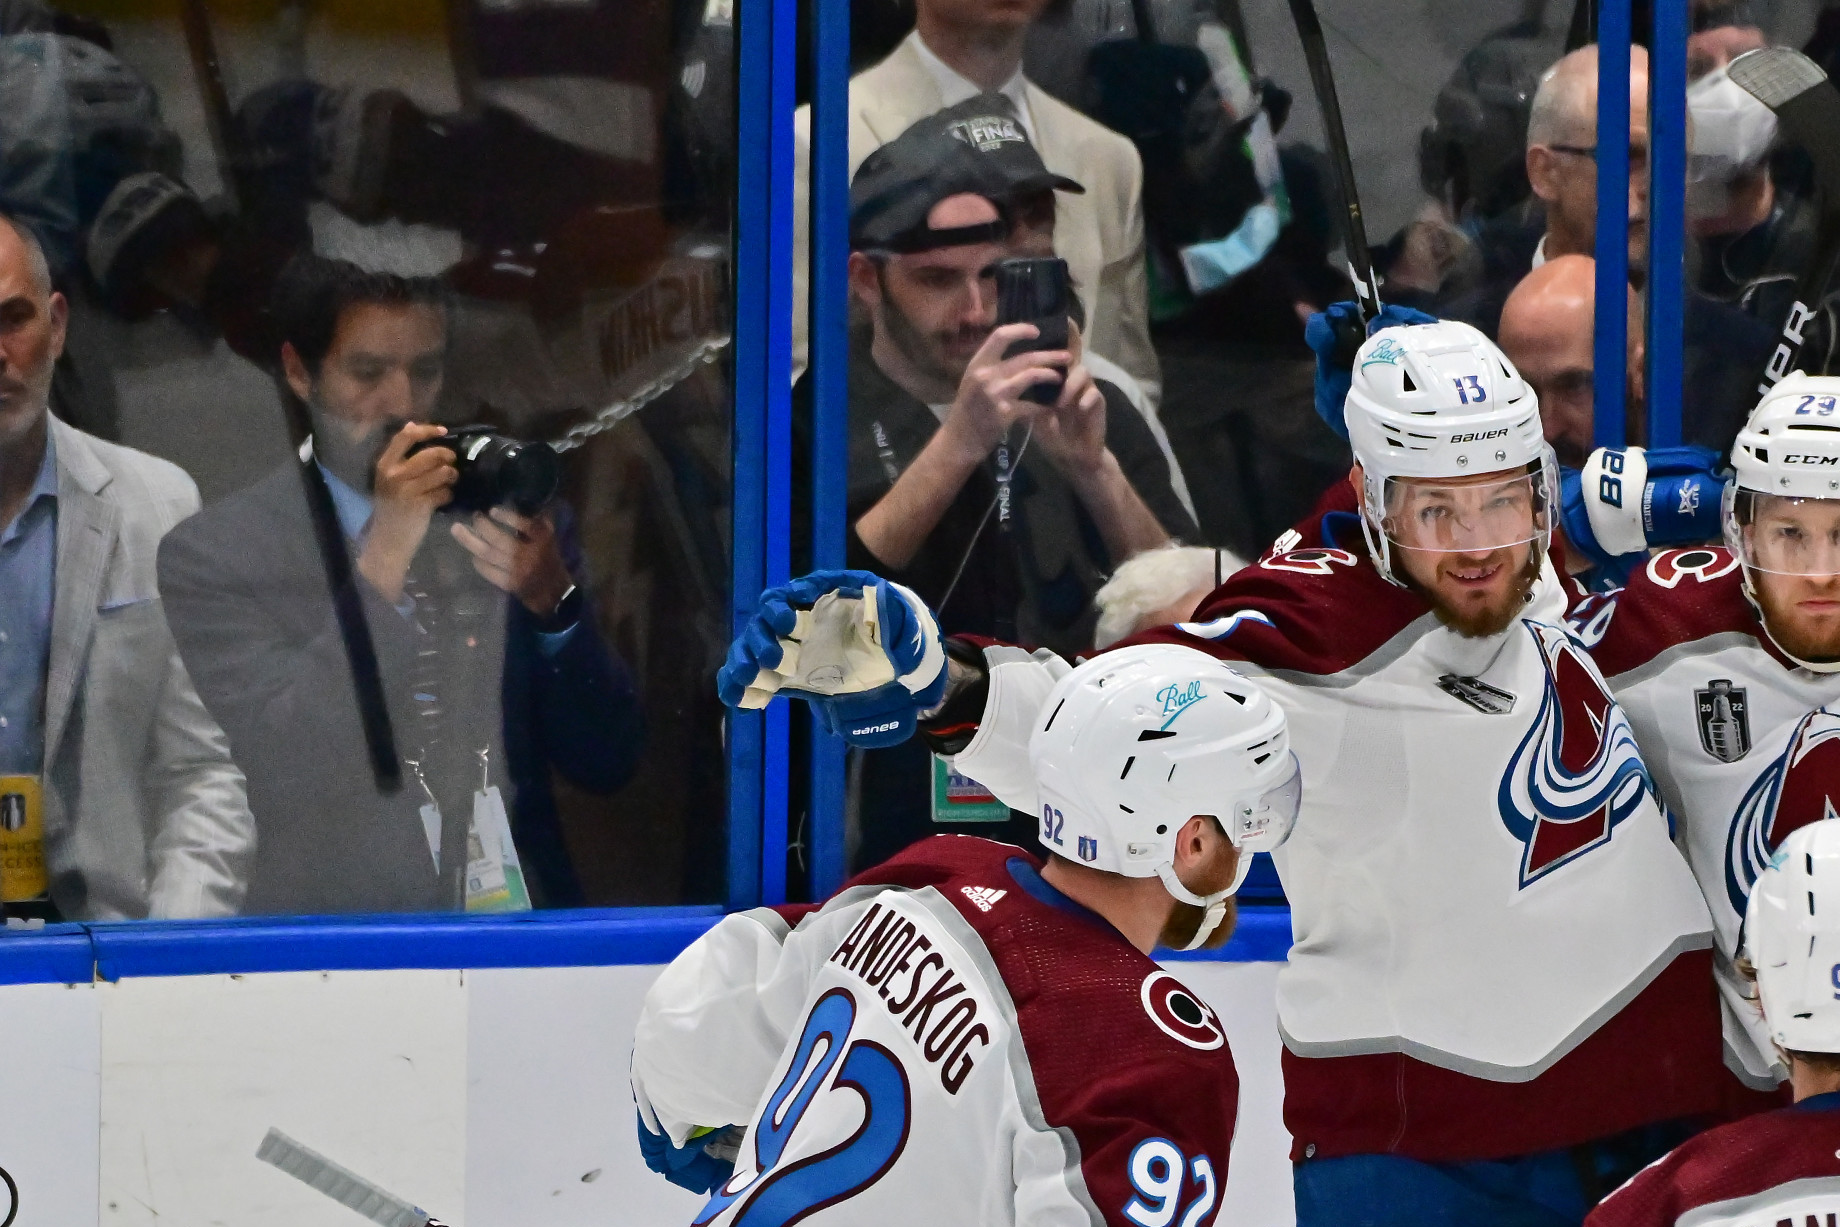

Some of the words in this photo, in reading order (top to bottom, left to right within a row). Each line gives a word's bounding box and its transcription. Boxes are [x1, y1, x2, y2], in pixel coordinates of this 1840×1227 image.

[1453, 375, 1487, 405] 13
[1784, 454, 1838, 466] CCM
[1156, 680, 1208, 723] Ball
[1701, 704, 1712, 712] 20
[1732, 703, 1743, 711] 22
[1044, 803, 1064, 847] 92
